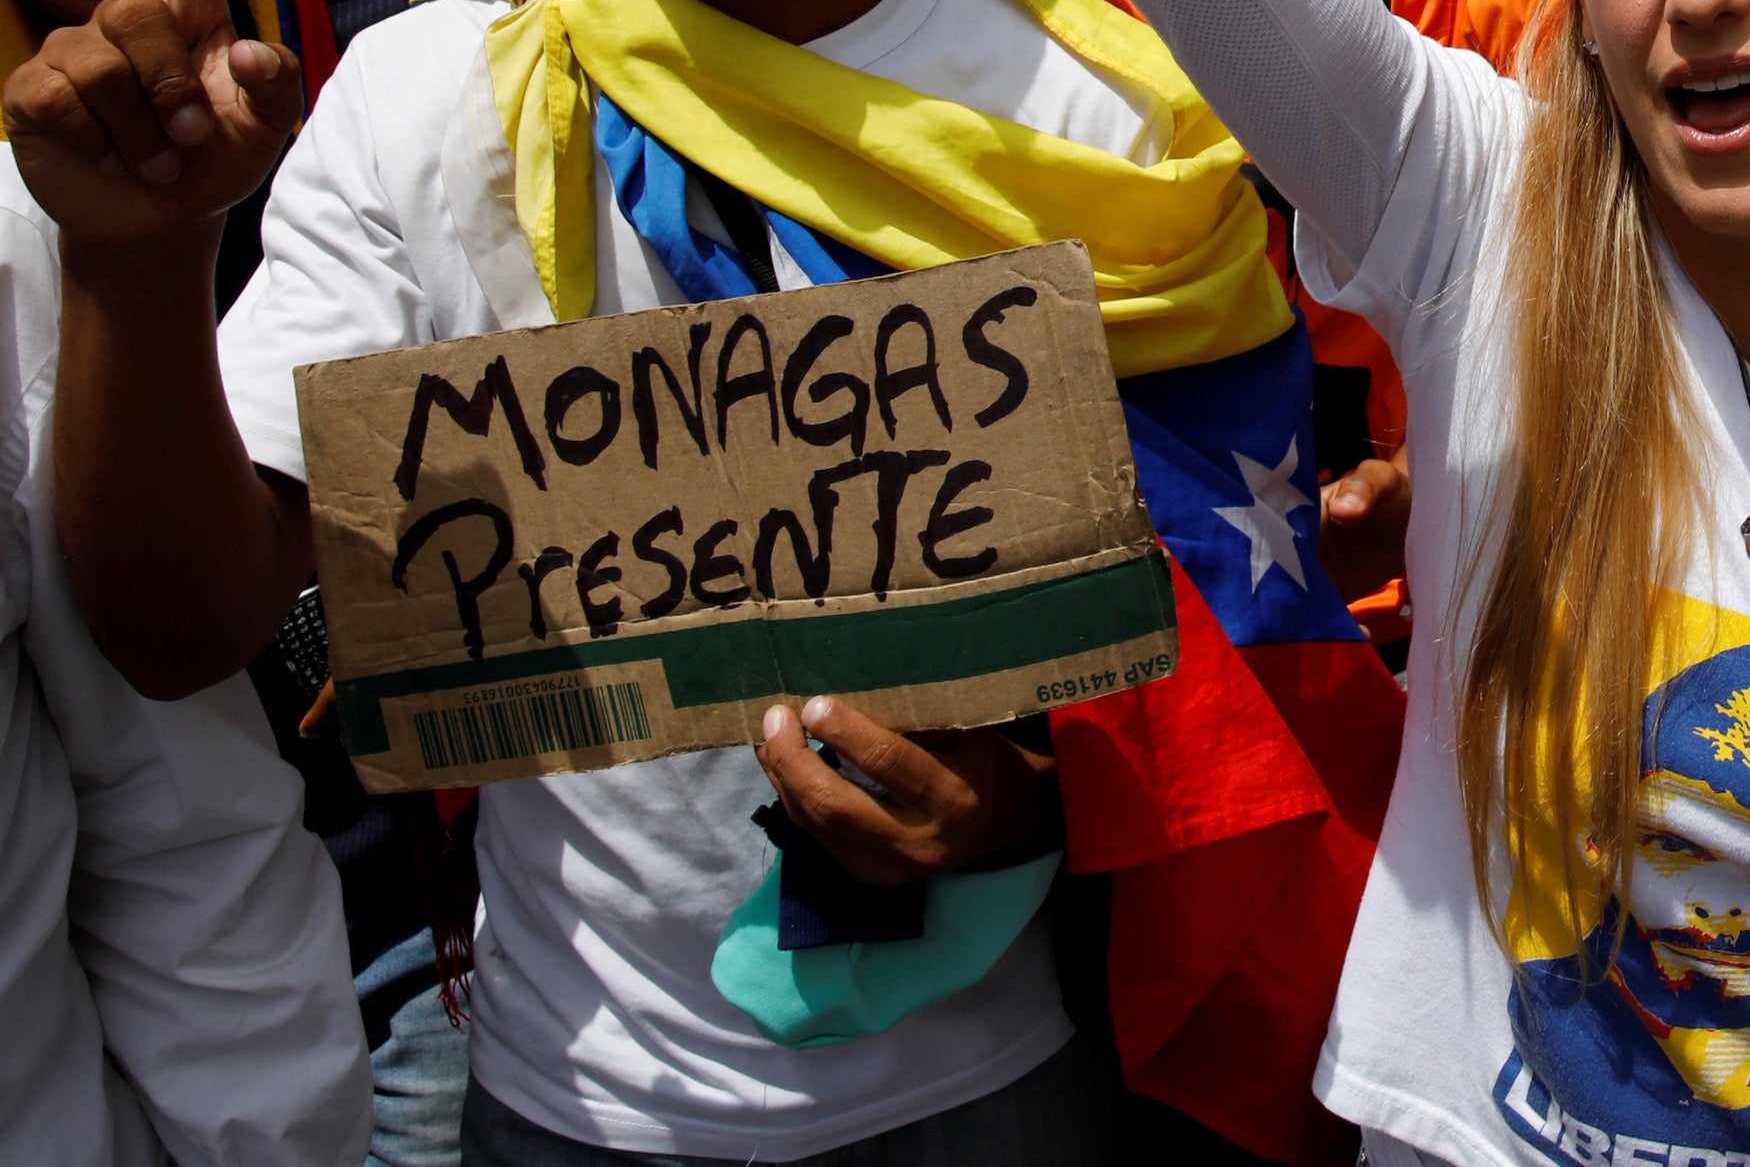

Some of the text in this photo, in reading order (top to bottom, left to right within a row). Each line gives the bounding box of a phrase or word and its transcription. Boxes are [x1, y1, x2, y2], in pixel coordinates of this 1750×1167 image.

[393, 285, 1038, 501] MONAGAS
[1036, 653, 1171, 704] SAP 441639
